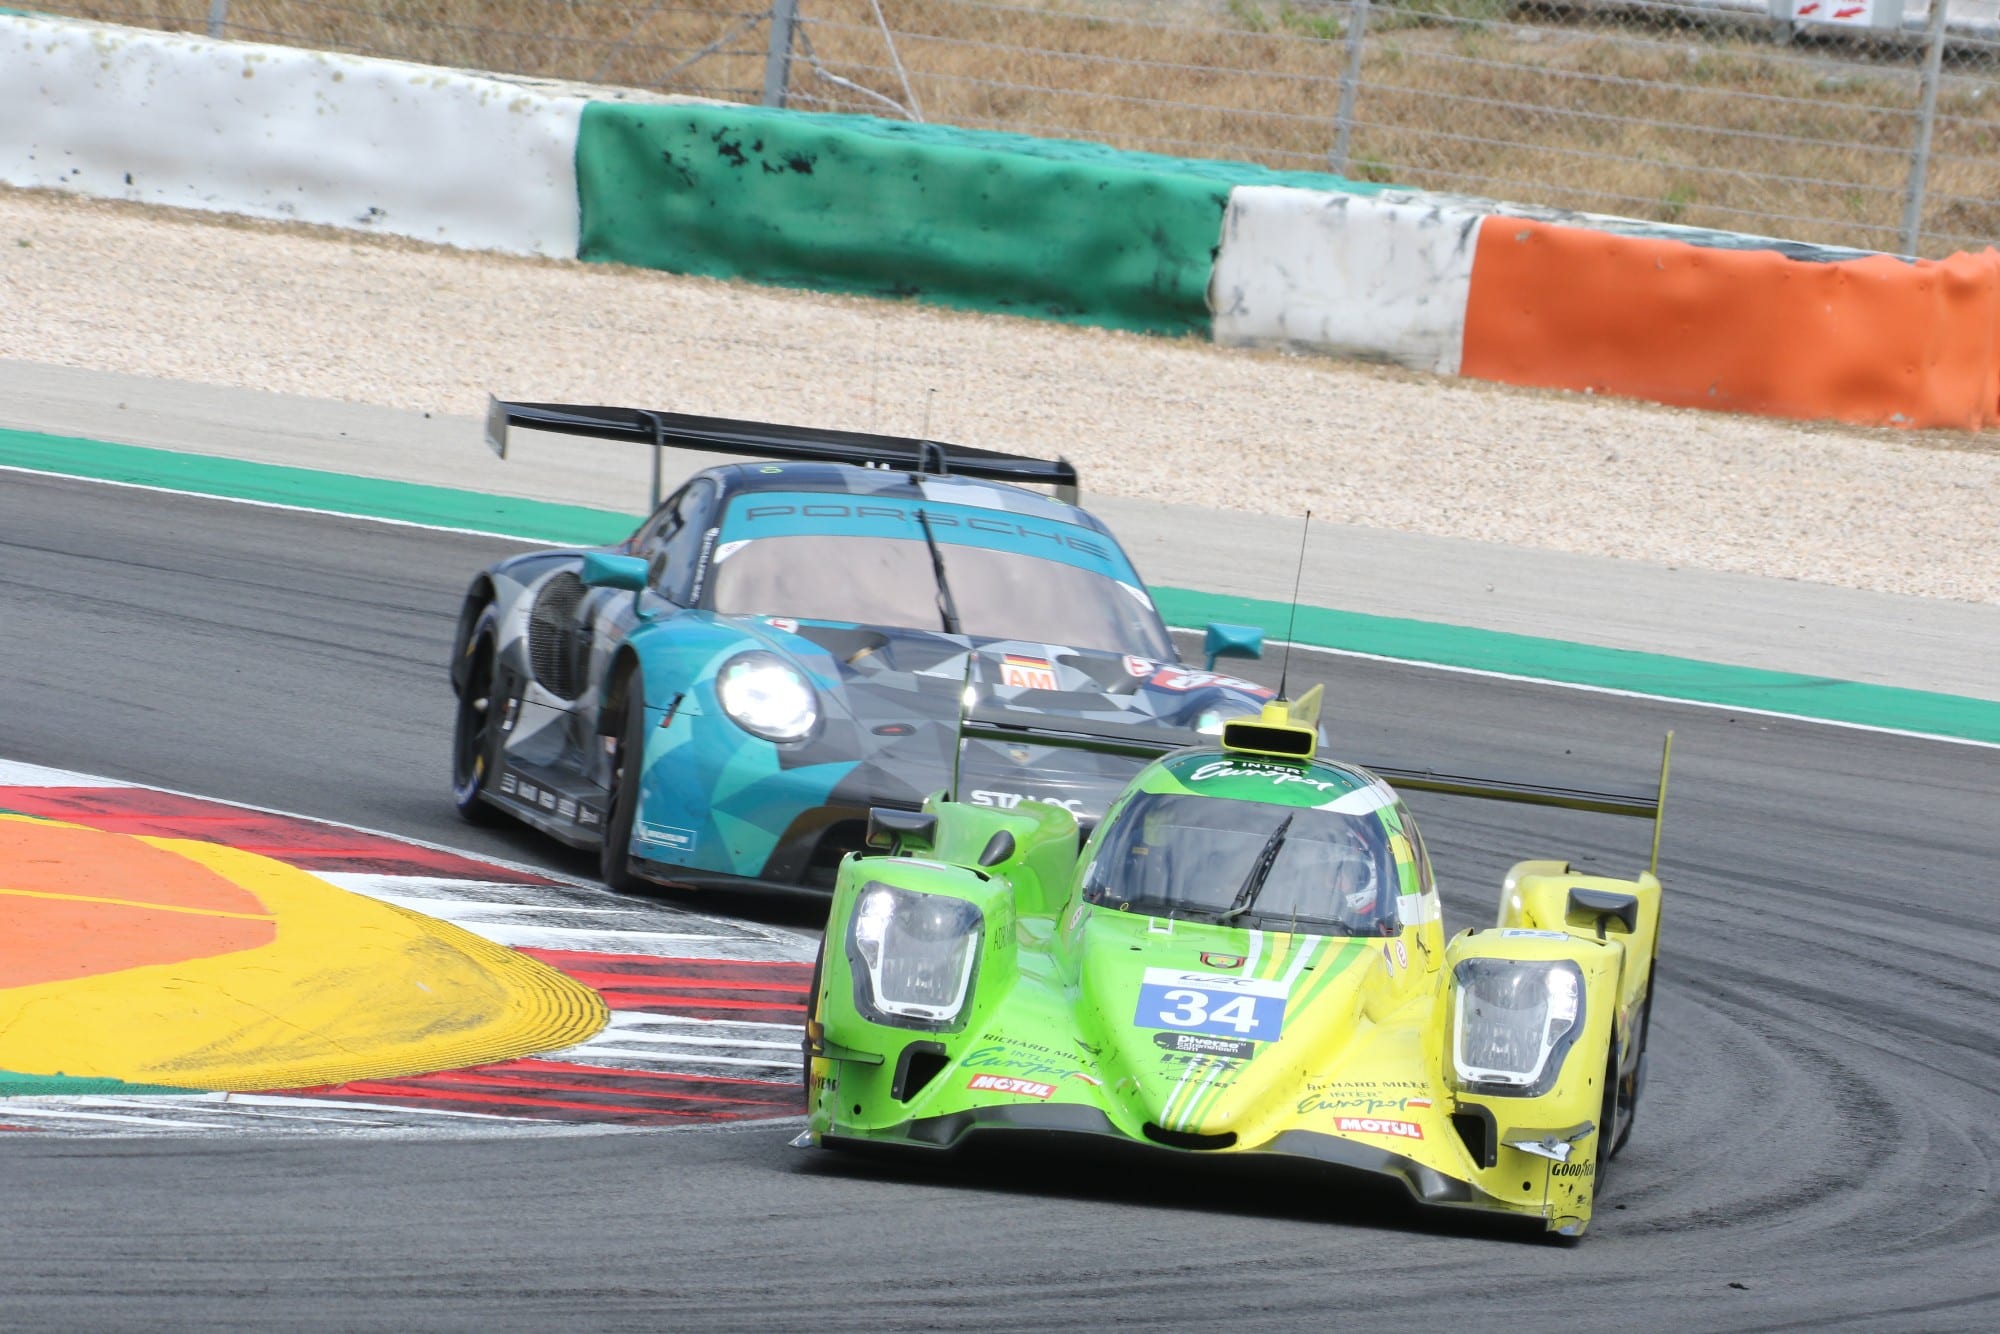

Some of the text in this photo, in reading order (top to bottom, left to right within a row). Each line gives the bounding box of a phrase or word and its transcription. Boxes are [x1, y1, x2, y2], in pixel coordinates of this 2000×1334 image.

[746, 505, 1112, 561] PORSCHE
[1010, 669, 1052, 691] AM
[1242, 762, 1301, 775] INTER
[1159, 989, 1260, 1033] 34
[983, 1033, 1049, 1053] RICHARD
[971, 1075, 1052, 1097] MOTUL
[1297, 1093, 1408, 1114] Europol
[1340, 1118, 1421, 1138] MOTUL
